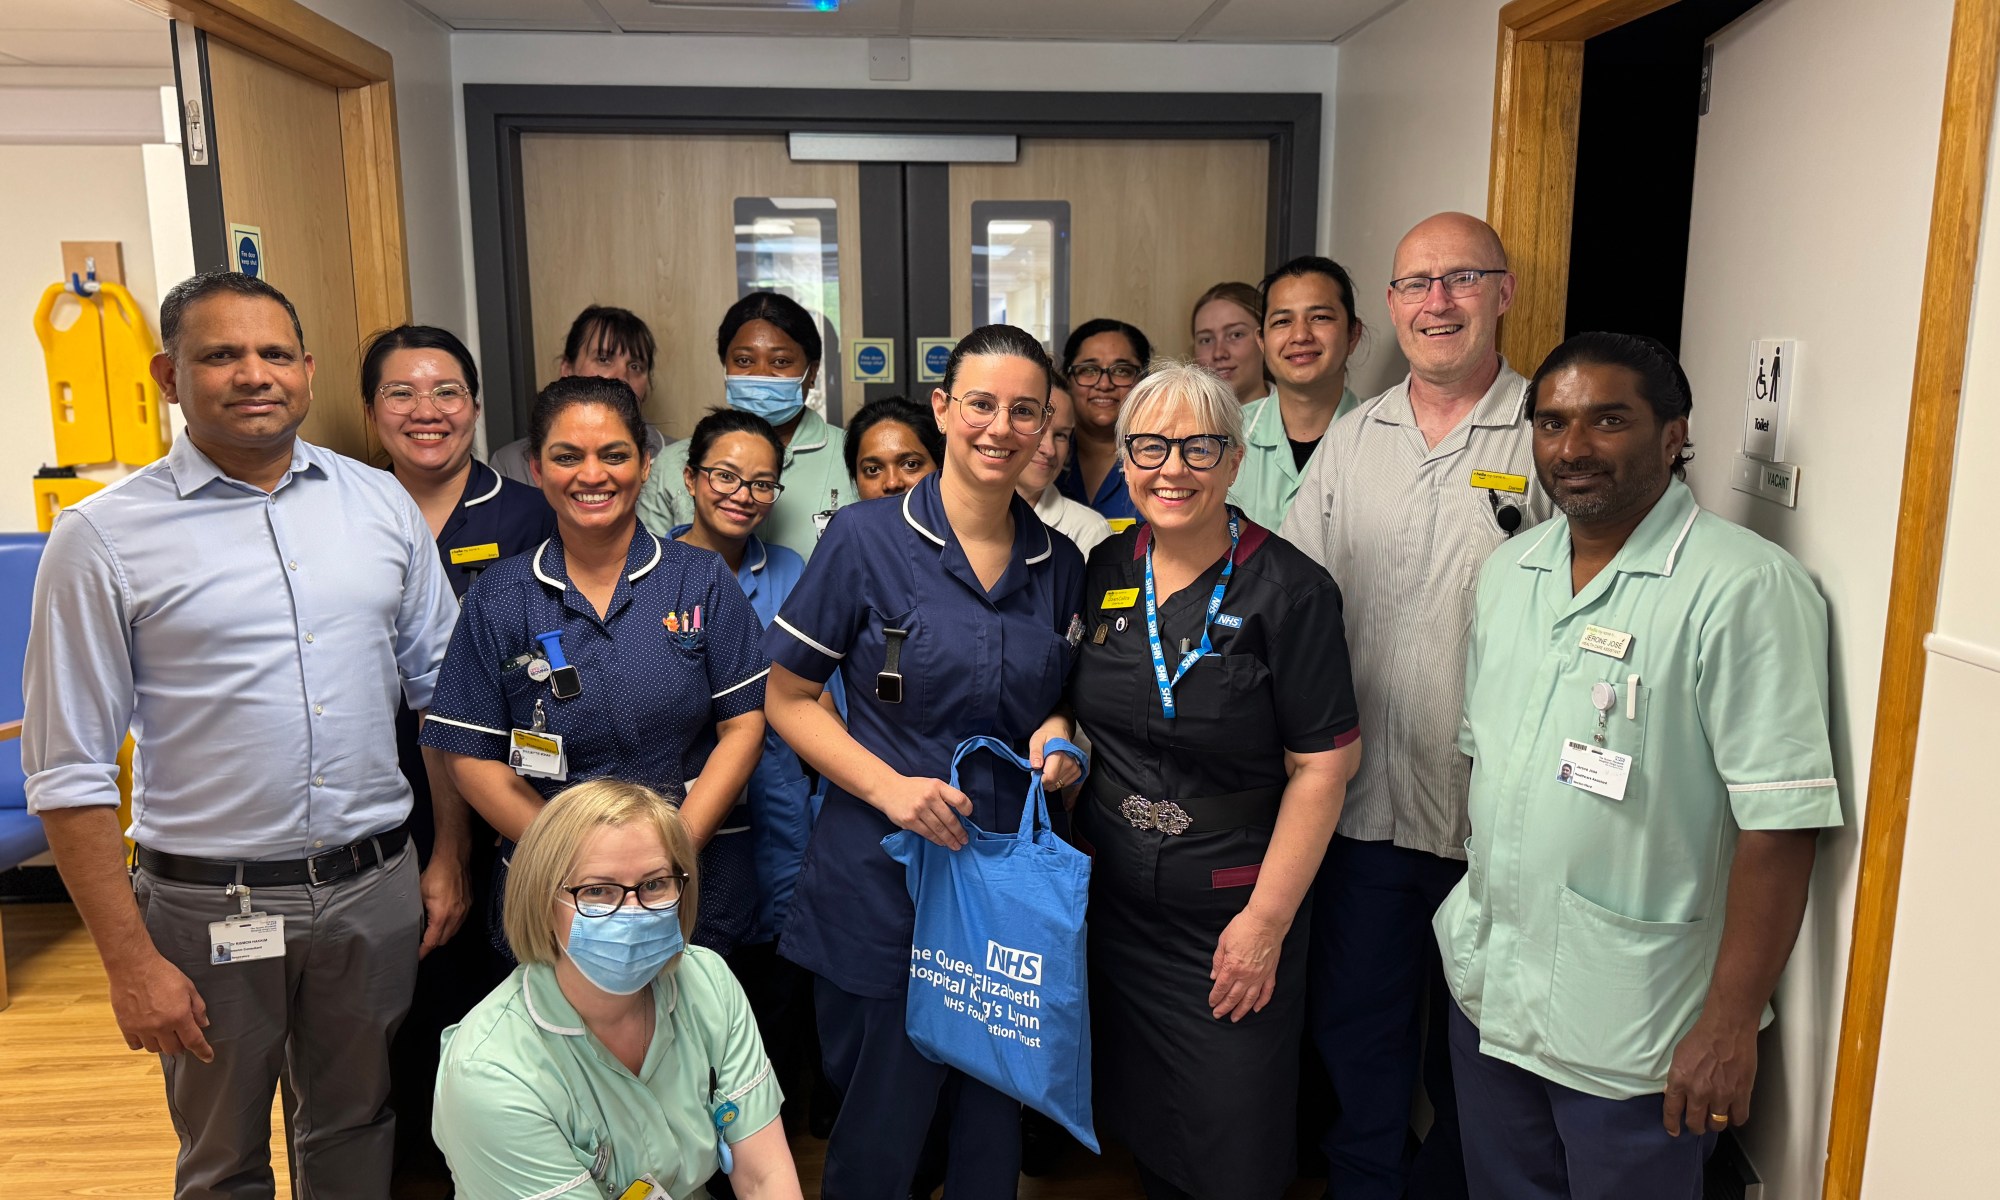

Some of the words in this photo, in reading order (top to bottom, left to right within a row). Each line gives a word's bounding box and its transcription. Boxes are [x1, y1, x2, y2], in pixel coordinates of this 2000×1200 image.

[1754, 418, 1769, 432] Toilet
[1767, 472, 1789, 490] VACANT
[1145, 578, 1153, 595] NHS
[1146, 599, 1155, 616] NHS
[1208, 596, 1221, 615] NHS
[1148, 620, 1157, 637] NHS
[1218, 615, 1239, 627] NHS
[1152, 642, 1162, 660] NHS
[1181, 650, 1200, 669] NHS
[1156, 664, 1167, 682] NHS
[1161, 687, 1173, 707] NHS
[989, 944, 1039, 981] NHS
[911, 944, 931, 960] he
[935, 949, 976, 978] Quee
[974, 973, 1040, 1009] Elizabeth
[969, 983, 1003, 1018] Kg's
[1008, 1003, 1040, 1030] Lynn
[943, 994, 965, 1013] NHS
[967, 1004, 1016, 1040] Fouation
[1018, 1029, 1041, 1048] Trust
